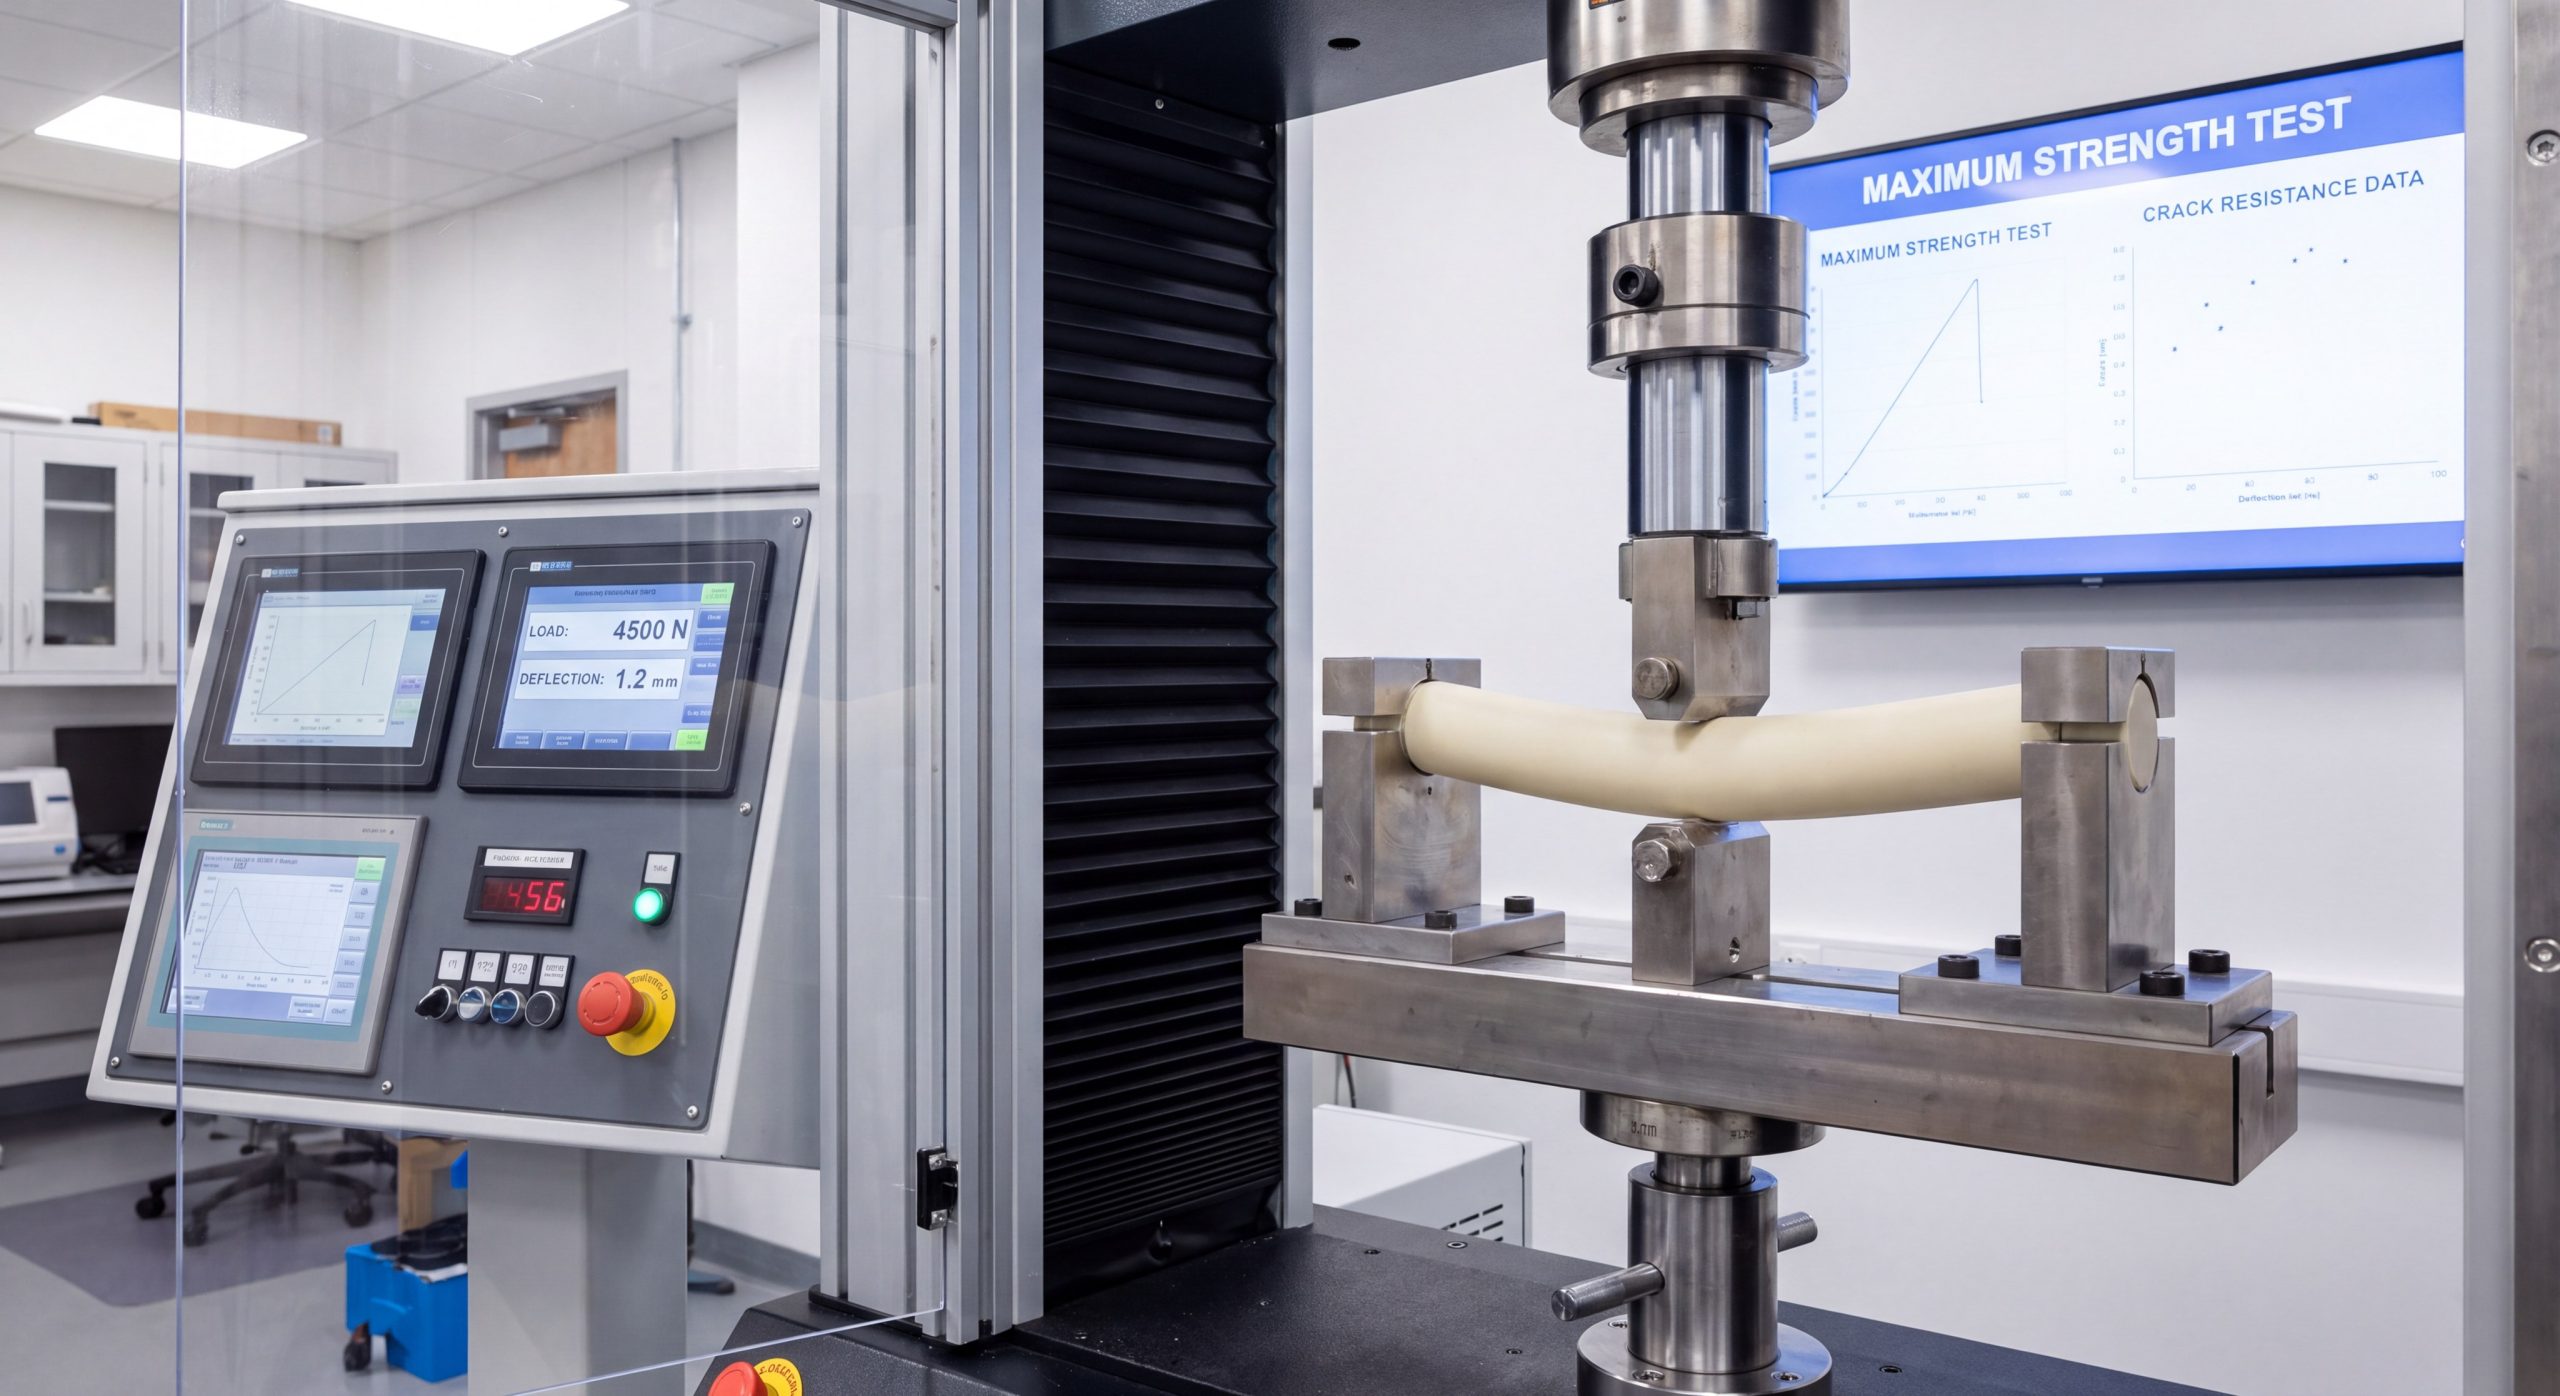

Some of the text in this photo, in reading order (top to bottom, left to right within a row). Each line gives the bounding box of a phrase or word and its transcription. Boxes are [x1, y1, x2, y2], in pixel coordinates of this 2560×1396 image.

[1863, 96, 2352, 205] MAXIMUM STRENGTH TEST
[2143, 169, 2425, 223] CRACK RESISTANCE DATA
[1821, 221, 2052, 267] MAXIMUM STRENGTH TEST
[2430, 469, 2448, 479] 100
[528, 618, 689, 641] LOAD: 4500 N
[519, 668, 678, 690] DEFLECTION: 1.2 mm
[507, 880, 565, 912] 456
